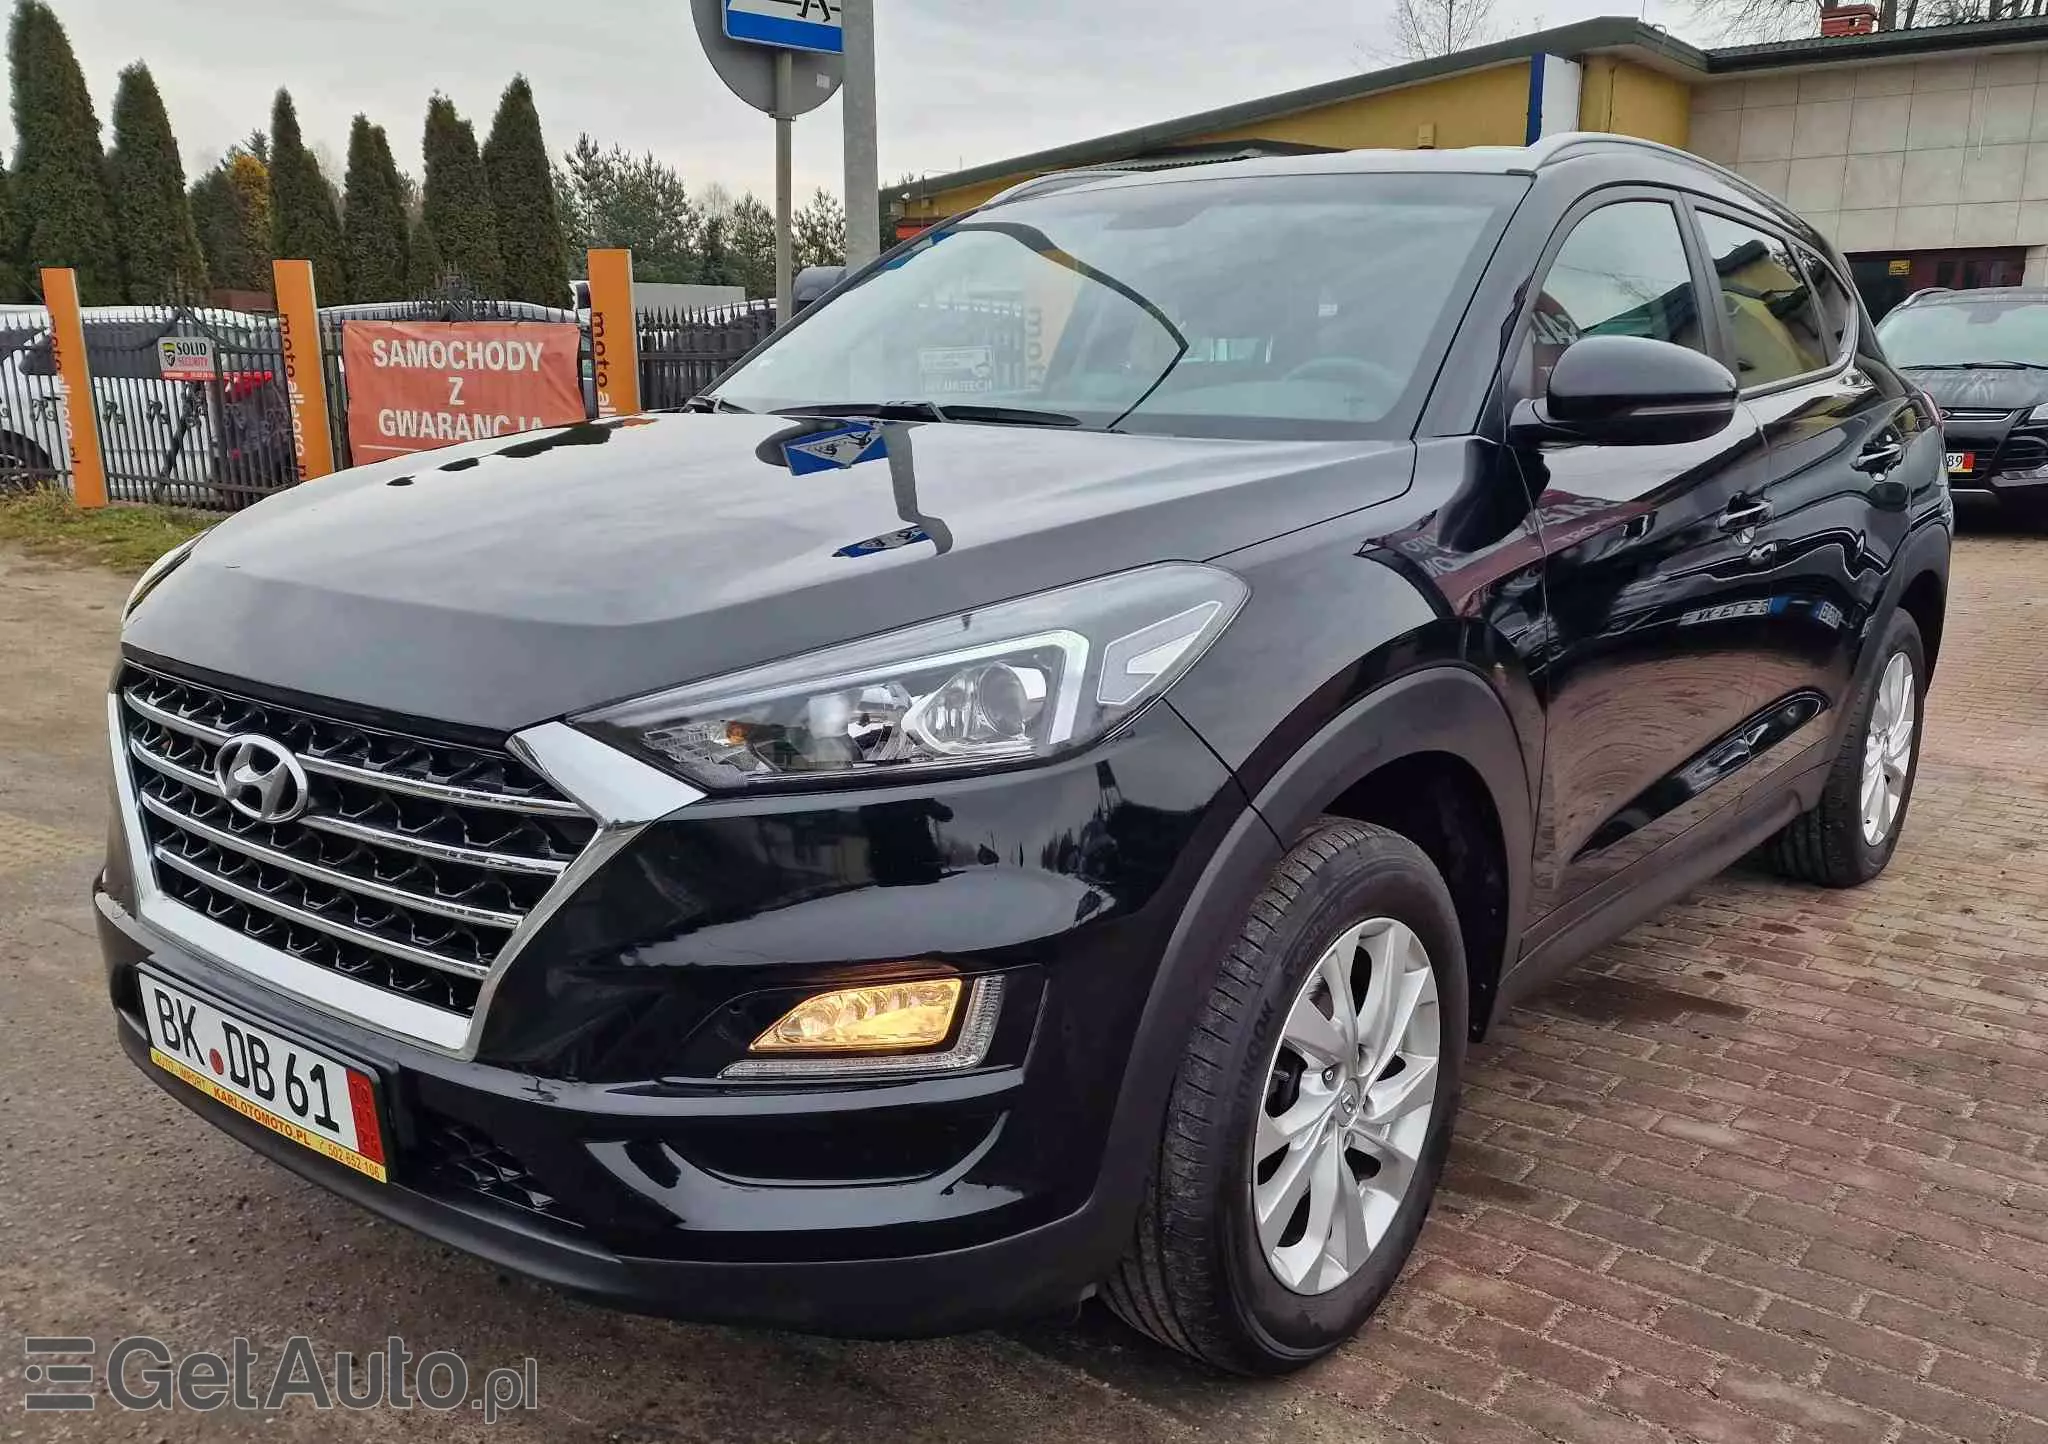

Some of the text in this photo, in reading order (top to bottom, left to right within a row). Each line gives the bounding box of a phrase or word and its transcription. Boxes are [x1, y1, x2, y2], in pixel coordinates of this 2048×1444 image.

[176, 342, 207, 356] SOLID
[372, 339, 544, 371] SAMOCHODY
[448, 377, 465, 405] Z
[154, 987, 339, 1133] BK DB 61
